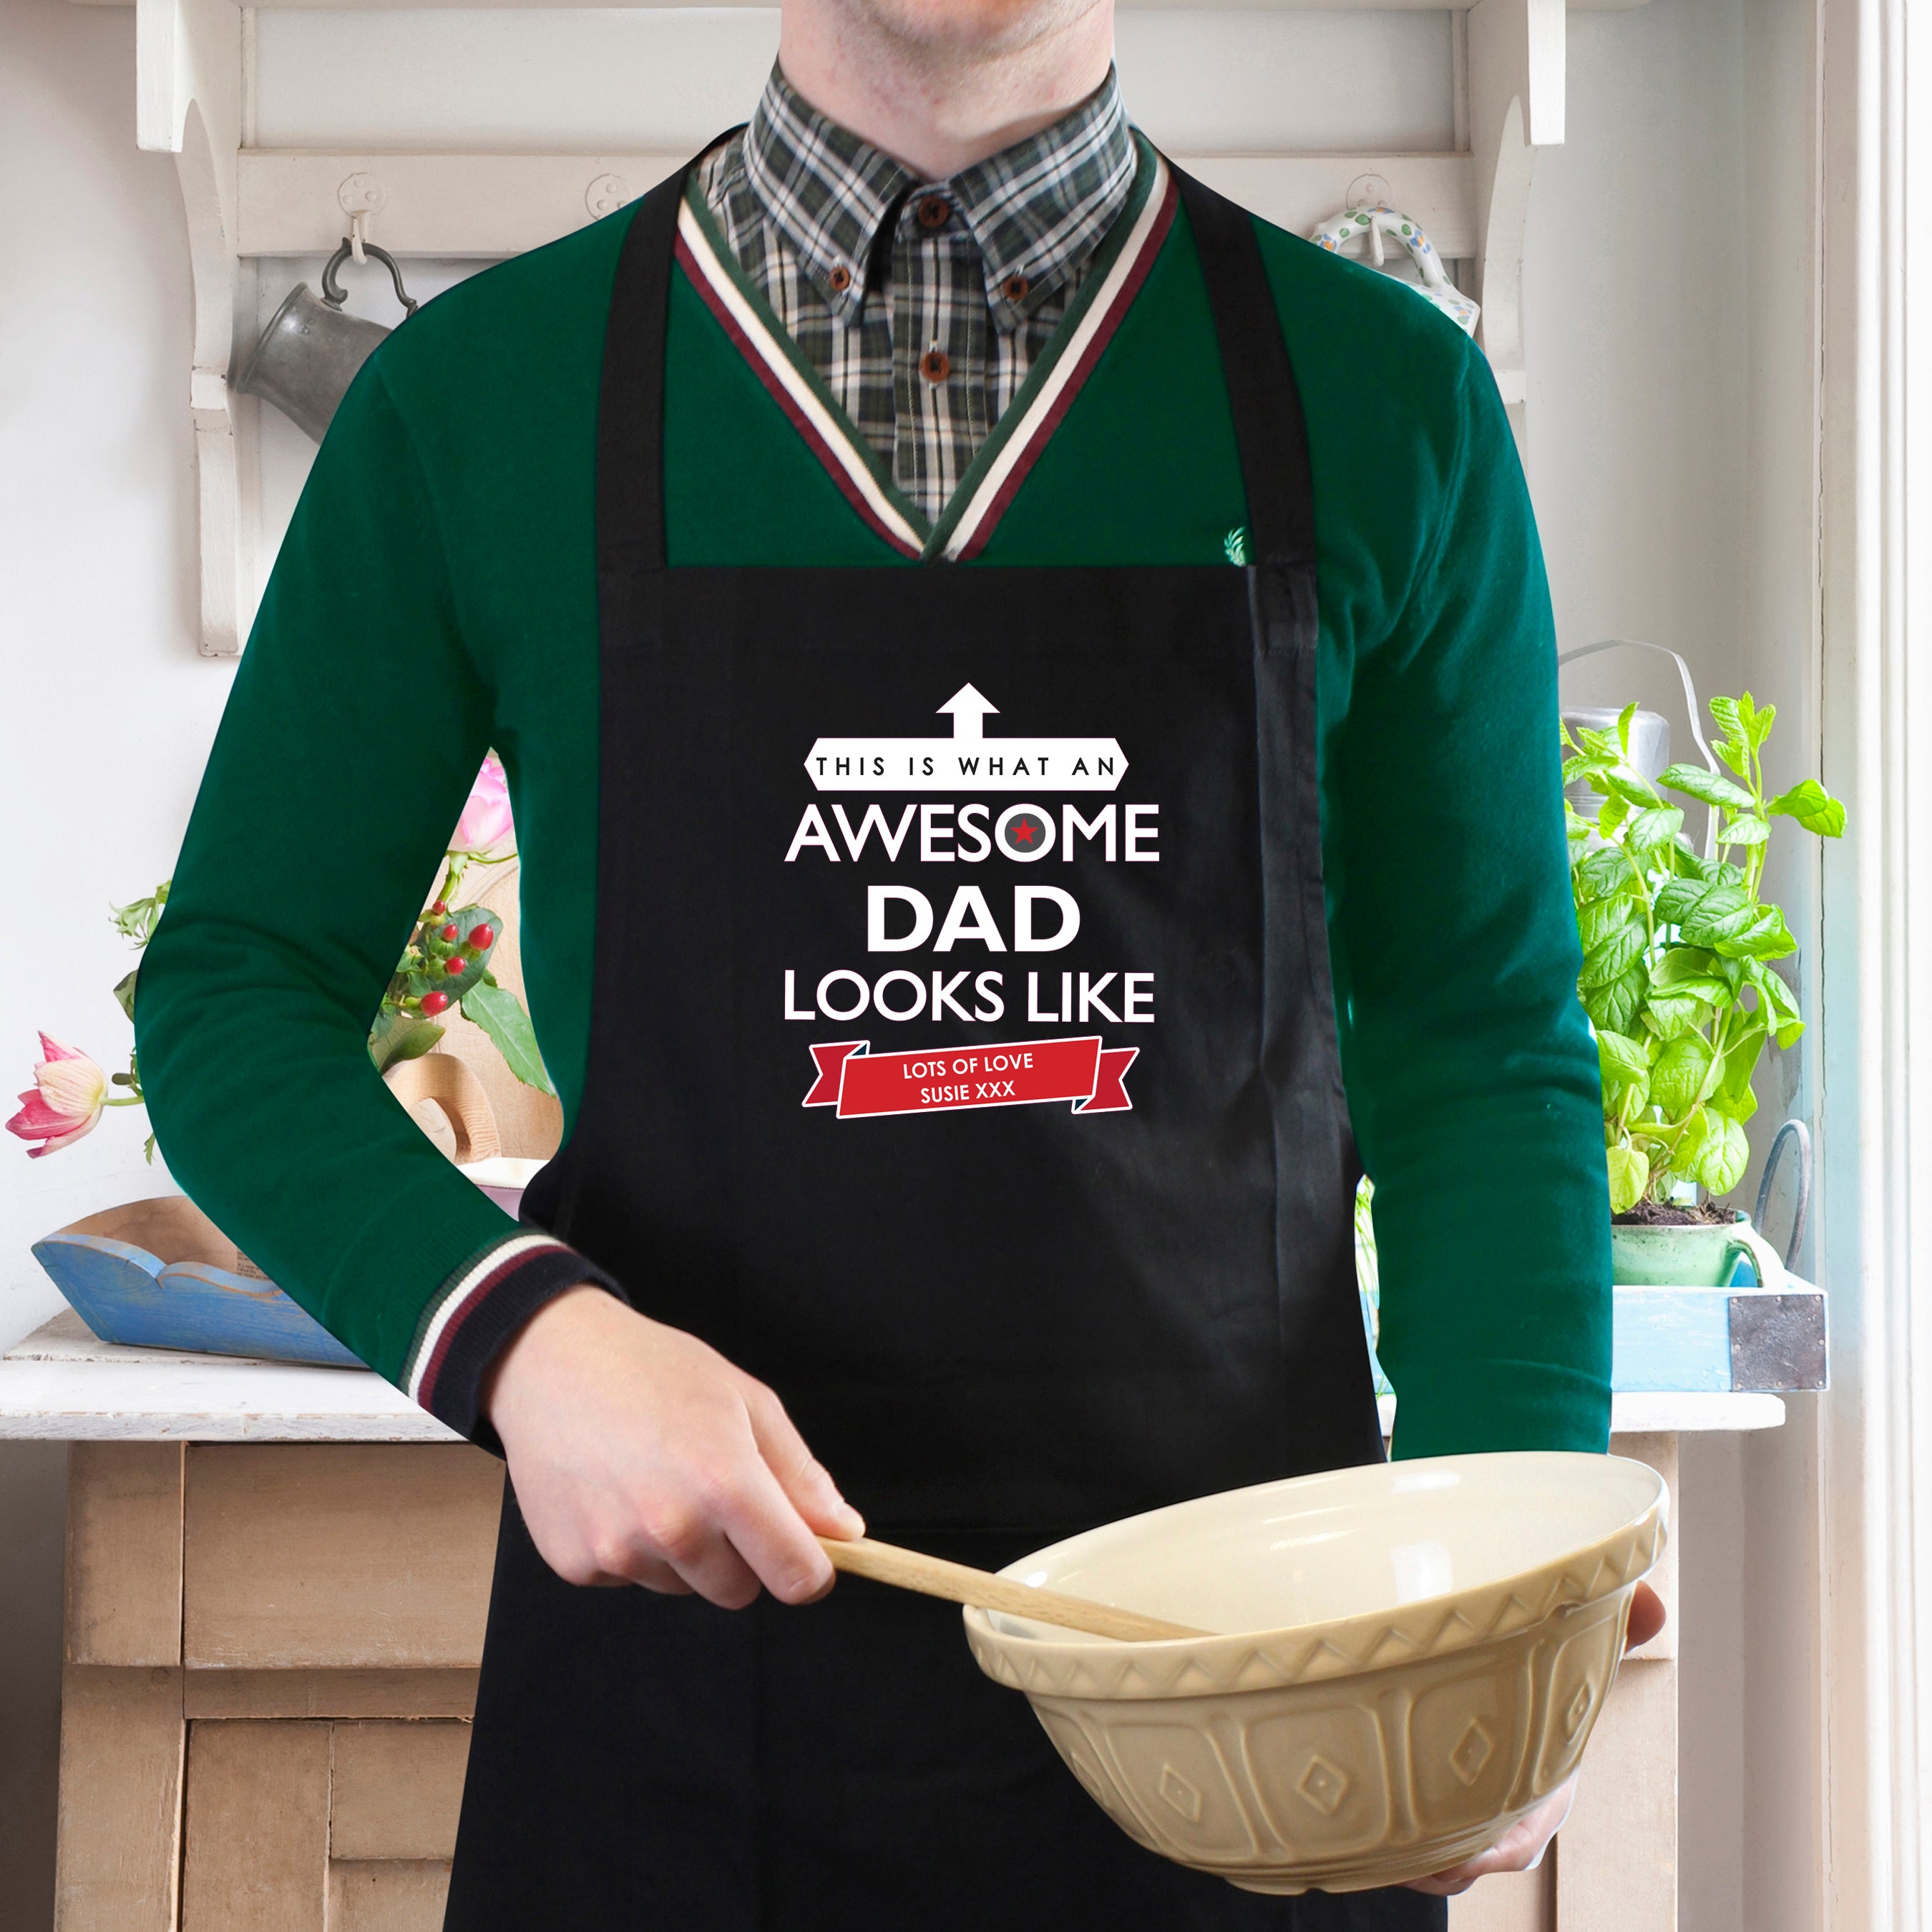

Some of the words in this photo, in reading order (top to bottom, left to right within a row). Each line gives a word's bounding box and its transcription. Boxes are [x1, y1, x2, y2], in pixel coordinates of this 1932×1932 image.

[816, 756, 884, 776] THIS
[909, 756, 934, 776] IS
[957, 756, 1049, 776] WHAT
[1071, 756, 1113, 776] AN
[784, 804, 1159, 862] AWESOME
[867, 885, 1080, 952] DAD
[784, 970, 1005, 1022] LOOKS
[1028, 972, 1155, 1023] LIKE
[903, 1060, 947, 1079] LOTS
[952, 1058, 978, 1075] OF
[984, 1053, 1033, 1072] LOVE
[920, 1084, 970, 1104] SUSIE
[975, 1080, 1016, 1099] XXX
